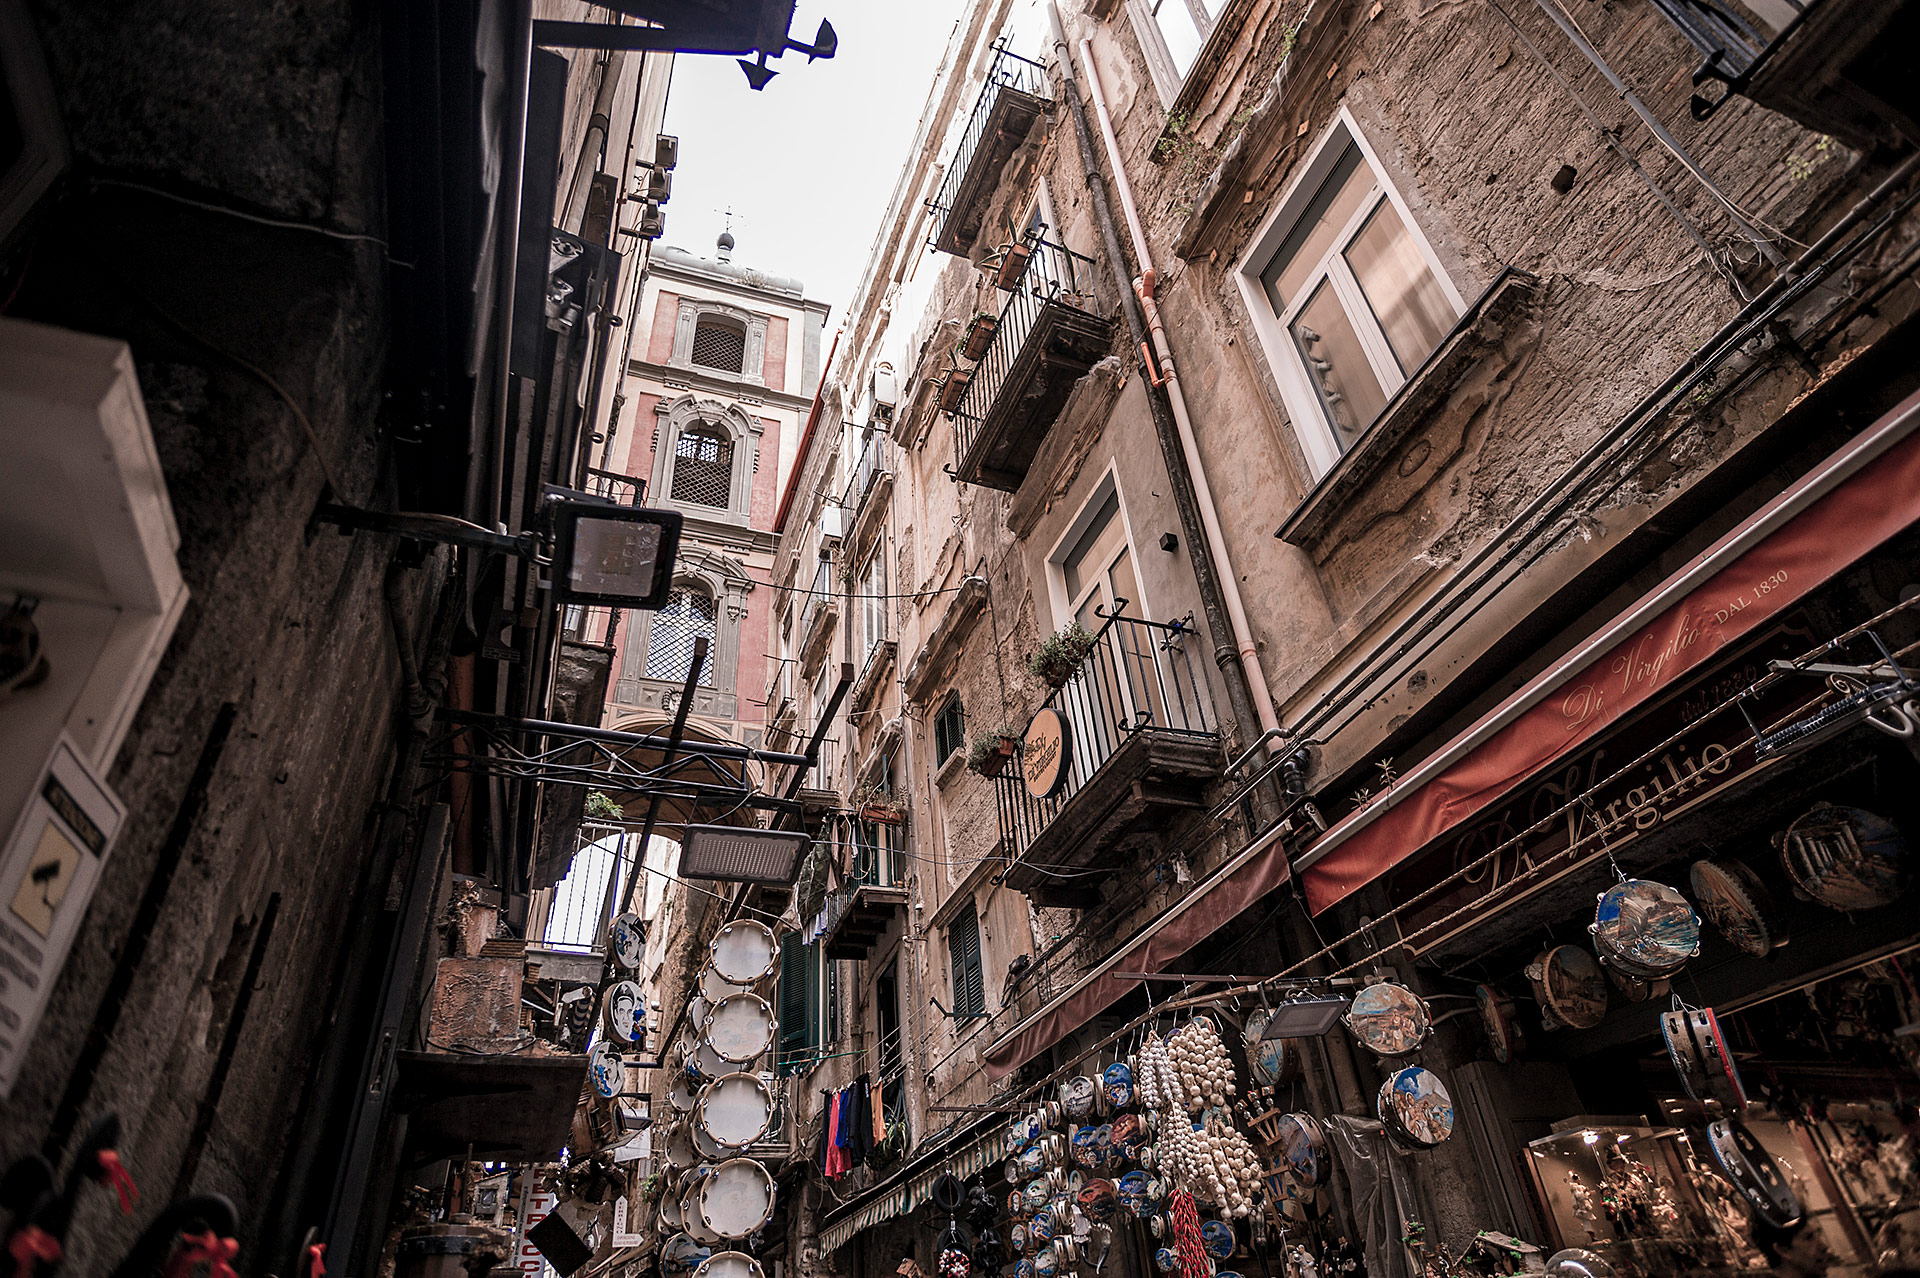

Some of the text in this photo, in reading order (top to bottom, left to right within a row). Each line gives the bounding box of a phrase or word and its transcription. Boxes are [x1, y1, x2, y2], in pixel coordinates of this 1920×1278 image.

[1562, 569, 1790, 733] Di Virgilio DAL 1830
[1529, 740, 1734, 862] Virgilio
